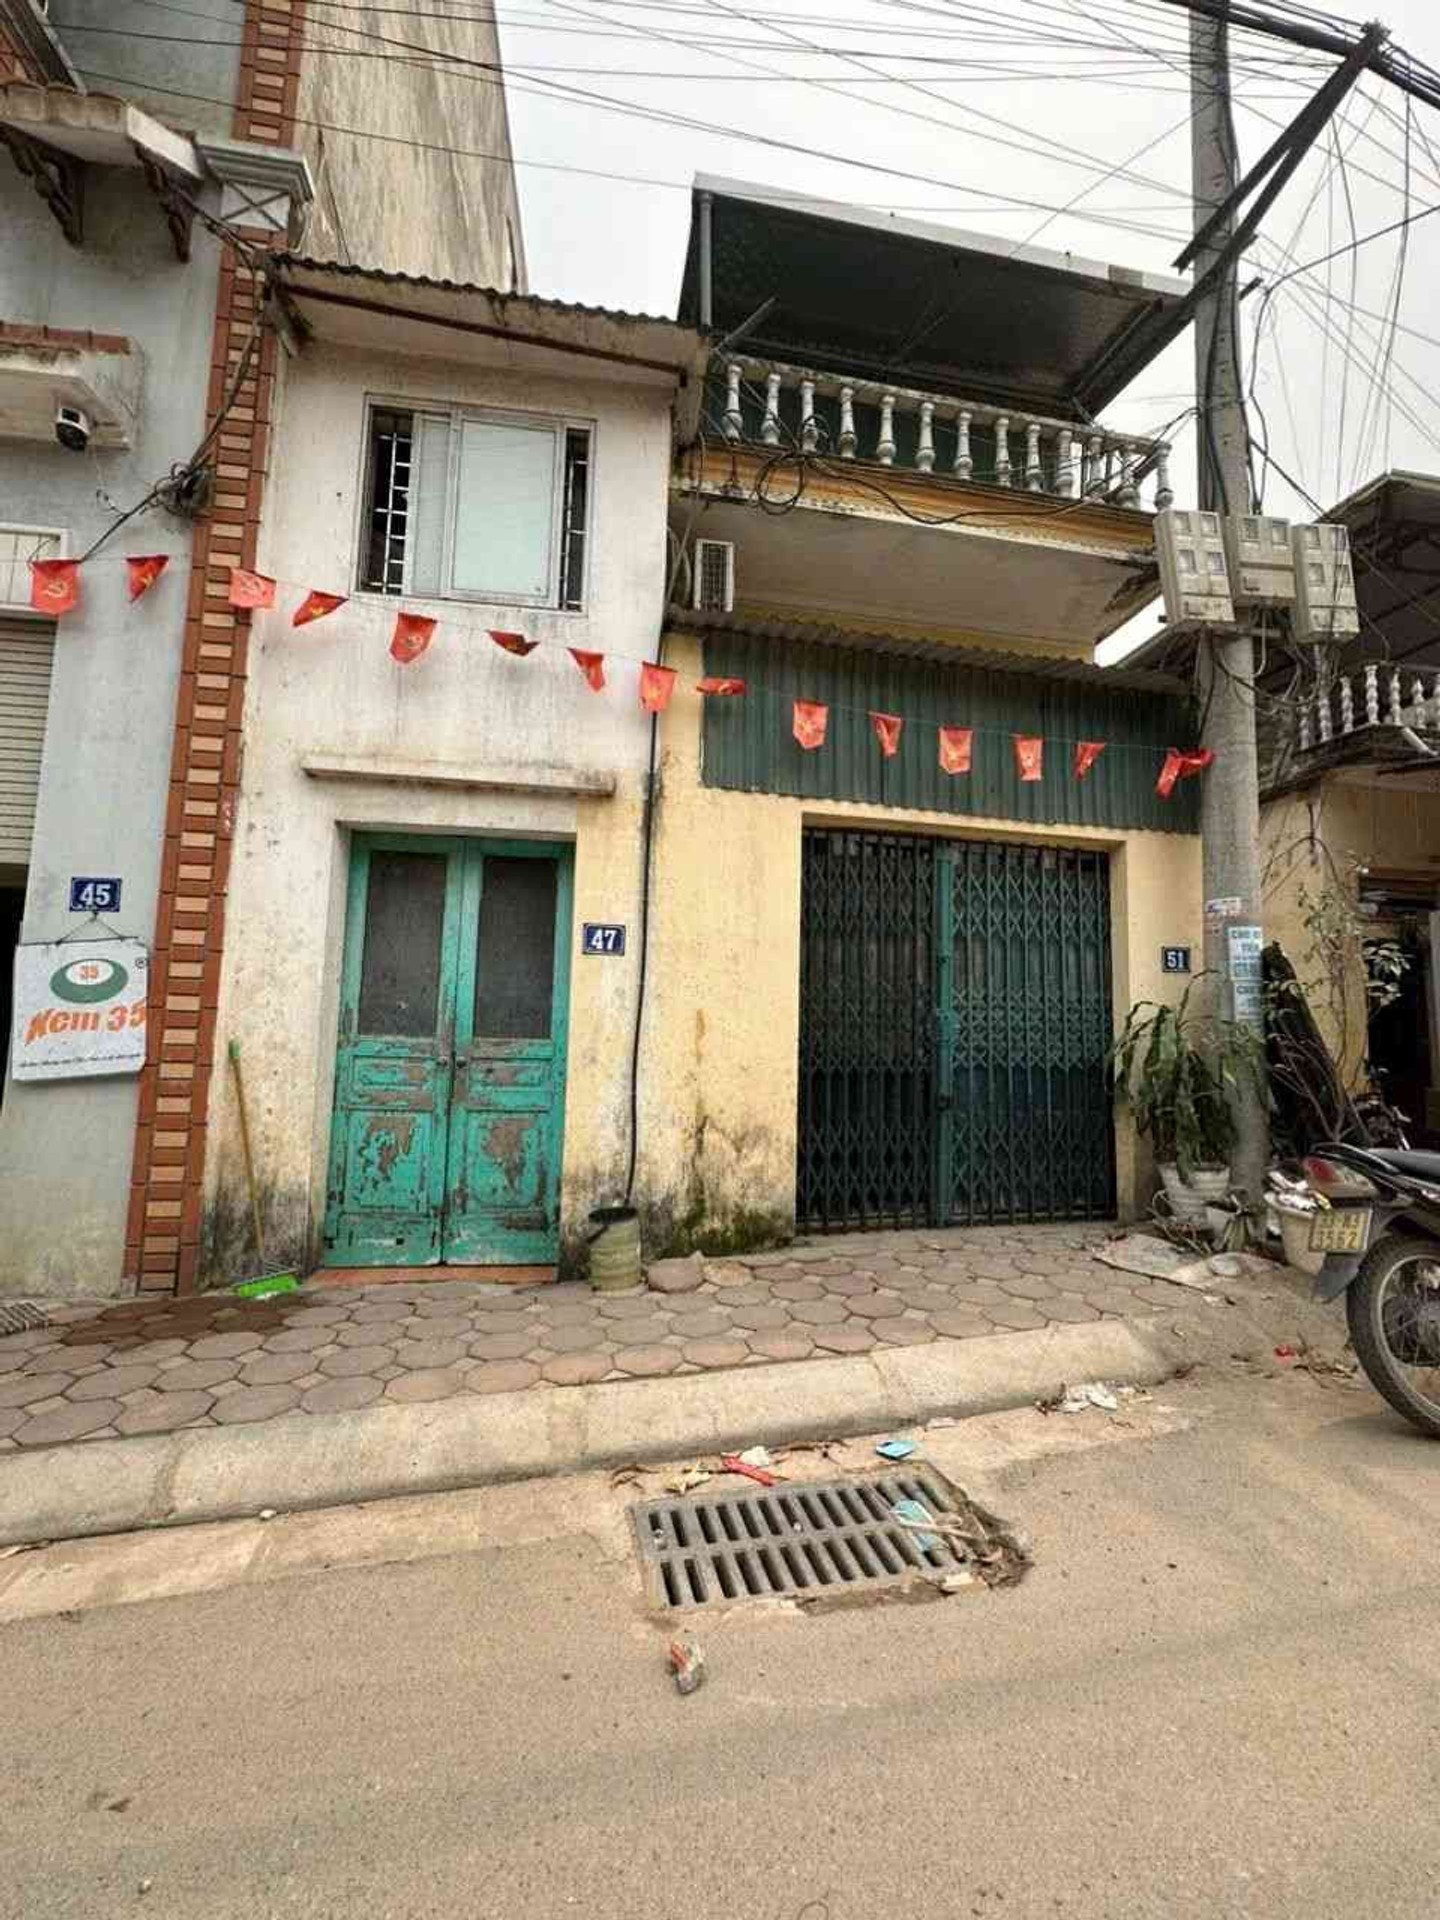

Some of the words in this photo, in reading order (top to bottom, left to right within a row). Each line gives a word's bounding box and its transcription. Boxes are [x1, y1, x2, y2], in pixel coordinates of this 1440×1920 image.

[79, 882, 111, 906] 45
[591, 928, 617, 950] 47
[1166, 950, 1185, 969] 51
[106, 1000, 147, 1033] 35
